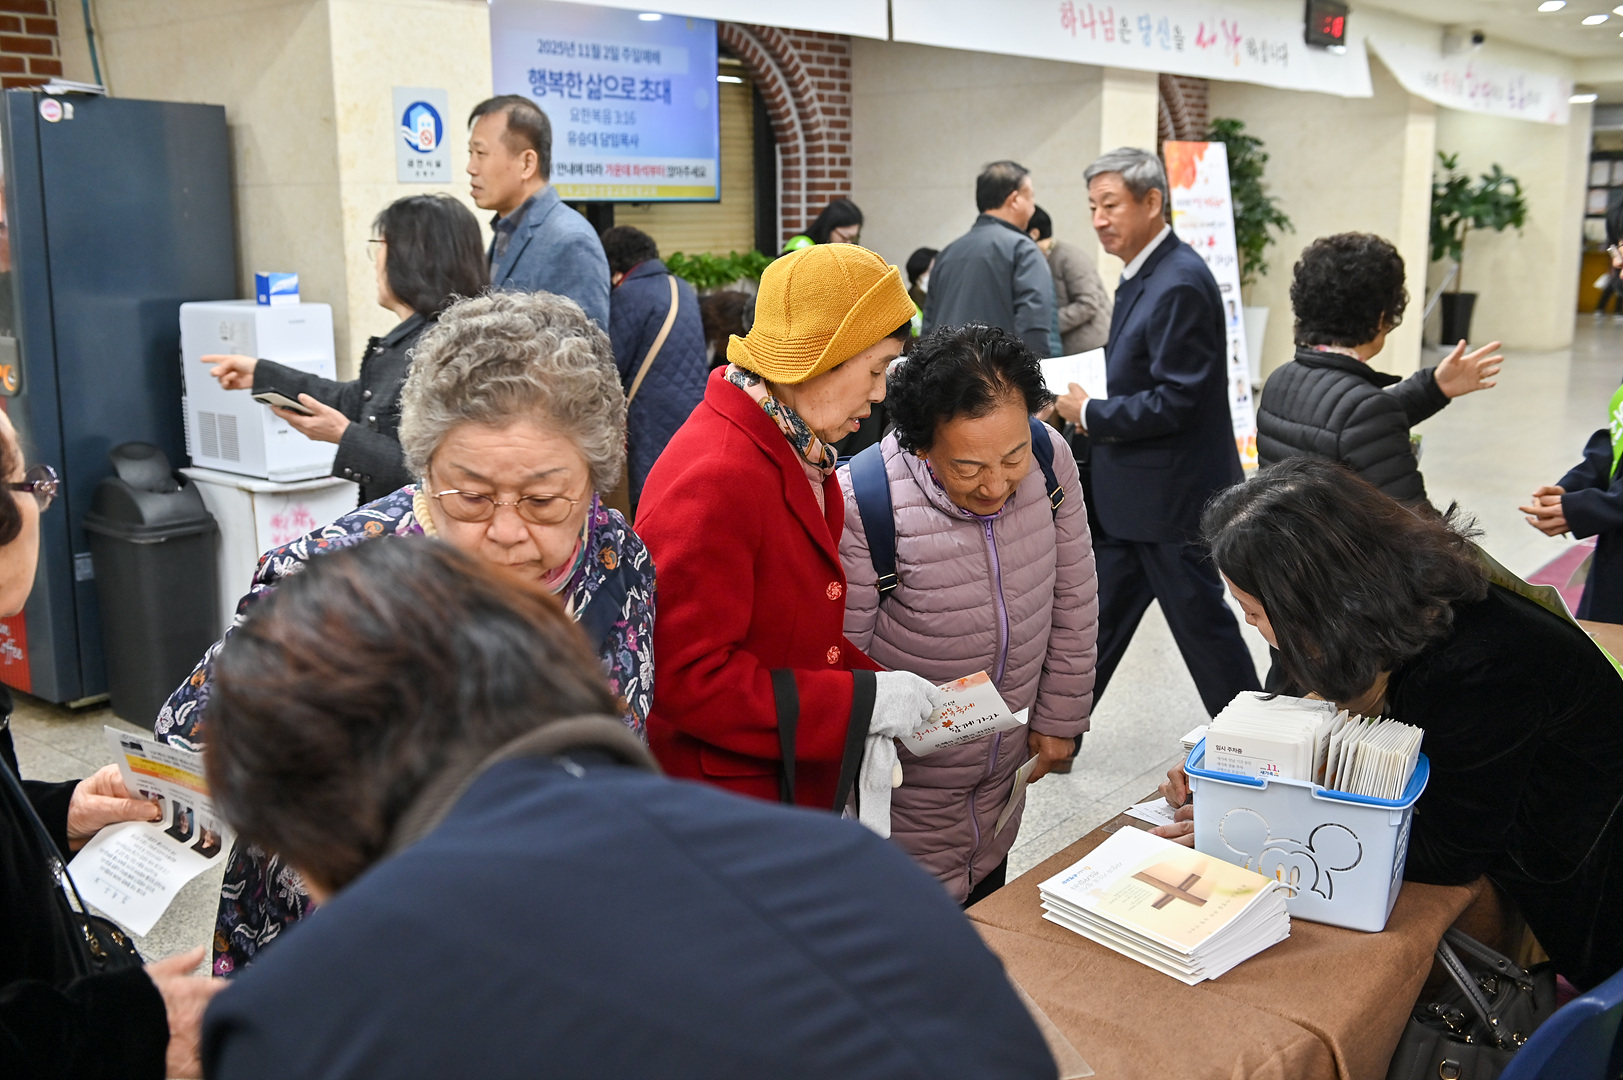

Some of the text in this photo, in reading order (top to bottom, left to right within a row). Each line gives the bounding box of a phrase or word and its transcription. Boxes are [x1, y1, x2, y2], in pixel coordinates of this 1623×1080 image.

[1060, 2, 1131, 44] 하나님은
[1137, 13, 1184, 52] 당신을
[537, 39, 661, 65] 2025년 11월 2일 주일예배
[528, 68, 670, 105] 행복한 삶으로 초대
[569, 107, 637, 126] 요한복음 3:16
[600, 132, 639, 149] 담임목사
[556, 162, 583, 176] 안내에
[585, 163, 603, 176] 따라
[605, 163, 631, 178] 가운데
[948, 713, 999, 733] 함께 가자
[1227, 746, 1243, 754] 주차증
